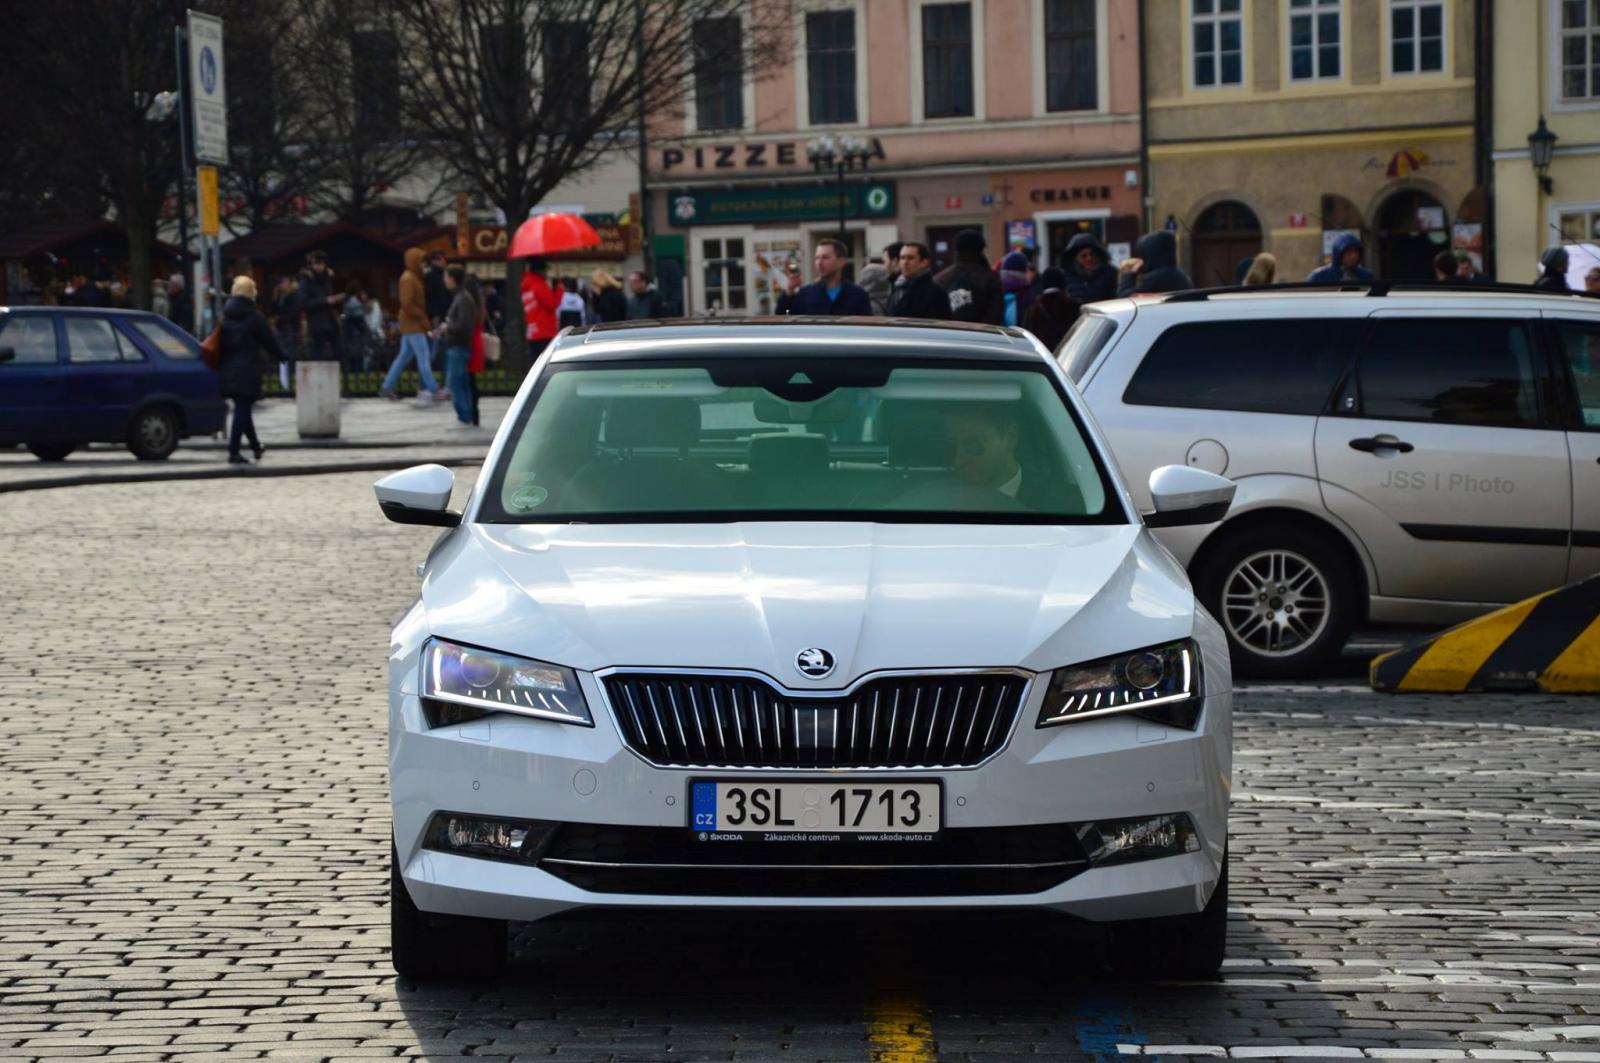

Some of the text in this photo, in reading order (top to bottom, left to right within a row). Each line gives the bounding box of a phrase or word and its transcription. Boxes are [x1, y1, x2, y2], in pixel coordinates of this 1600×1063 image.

[663, 138, 887, 170] PIZZEA
[1030, 186, 1111, 202] CHANGE
[726, 788, 921, 827] 3SL 1713
[696, 813, 713, 825] CZ
[858, 833, 933, 841] www.skoda-auto.cz
